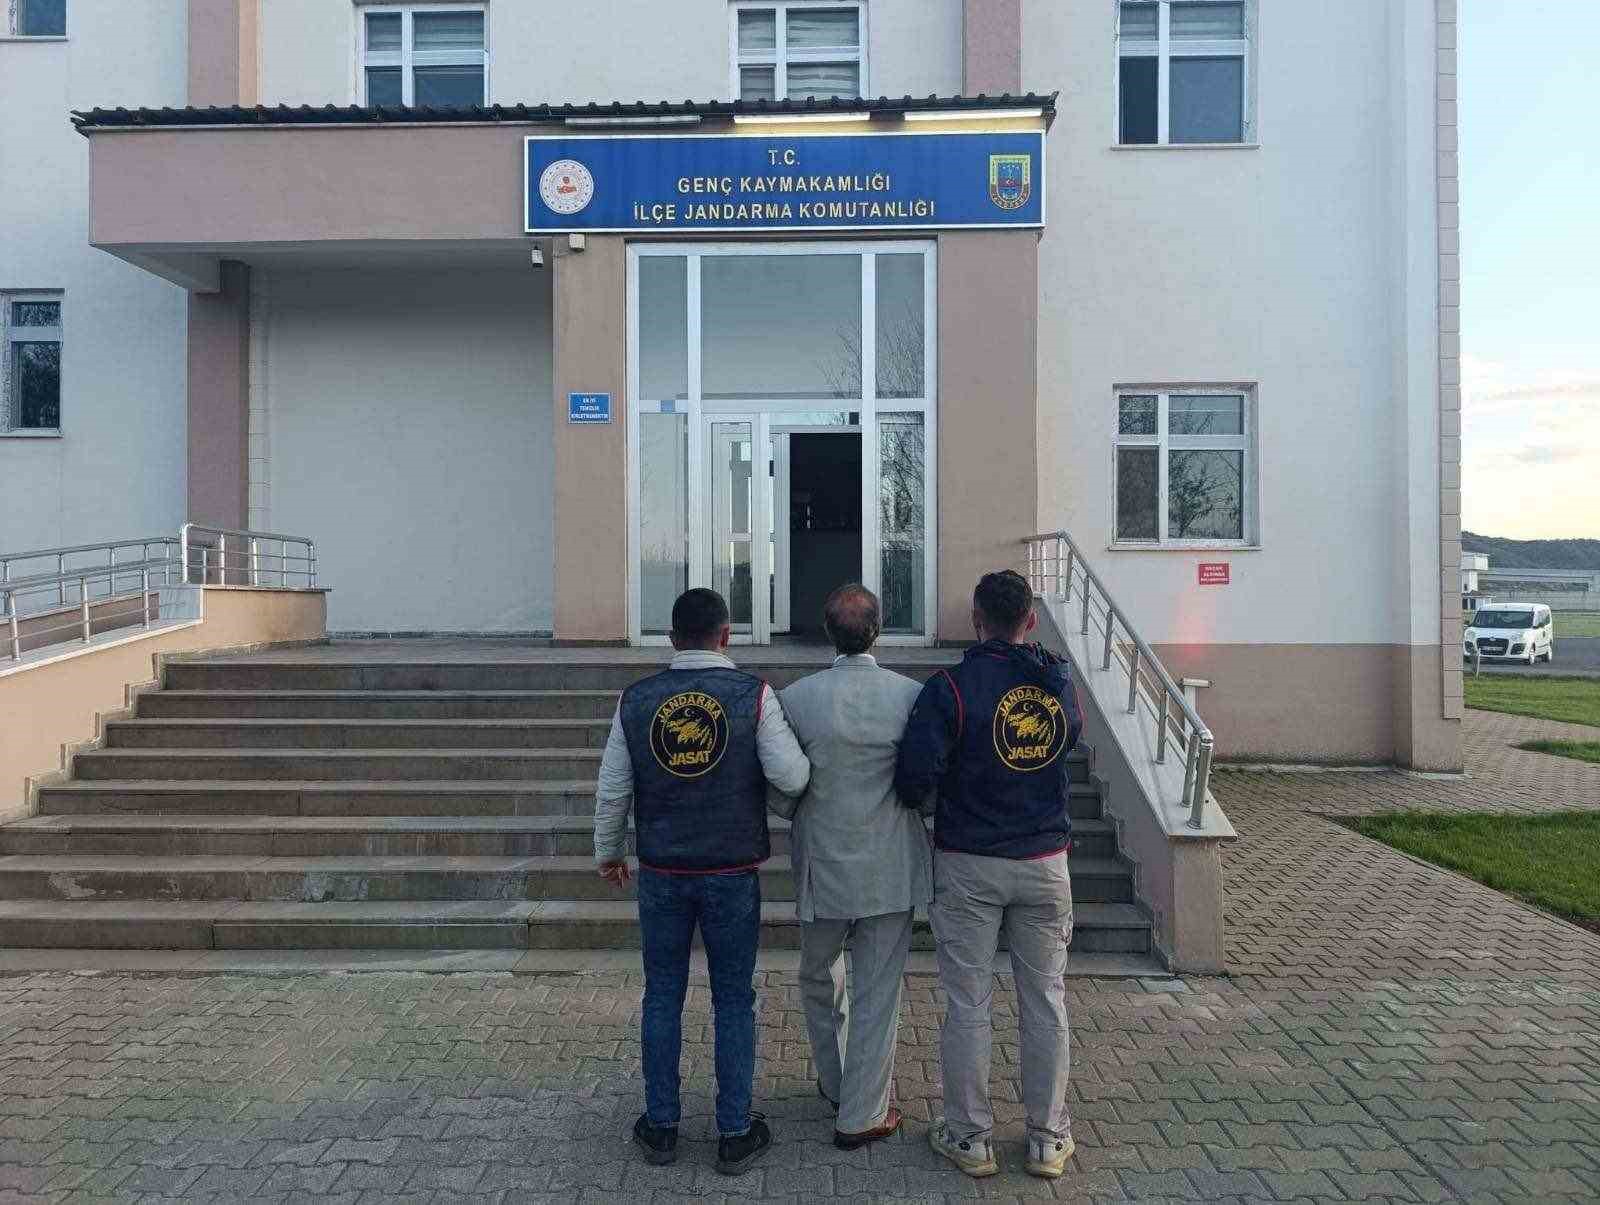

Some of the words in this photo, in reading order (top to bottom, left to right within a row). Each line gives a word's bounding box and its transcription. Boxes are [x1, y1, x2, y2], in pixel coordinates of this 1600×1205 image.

[768, 149, 800, 166] T.C.
[678, 176, 732, 196] GENÇ
[740, 172, 890, 193] KAYMAKAMLIĞI
[634, 202, 676, 224] İLÇE
[684, 202, 793, 220] JANDARMA
[799, 199, 935, 218] KOMUTANLIĞI
[657, 694, 722, 722] JANDARMA
[1000, 688, 1060, 717] JANDARMA
[668, 750, 711, 766] JASAT
[1007, 745, 1049, 760] JASAT
